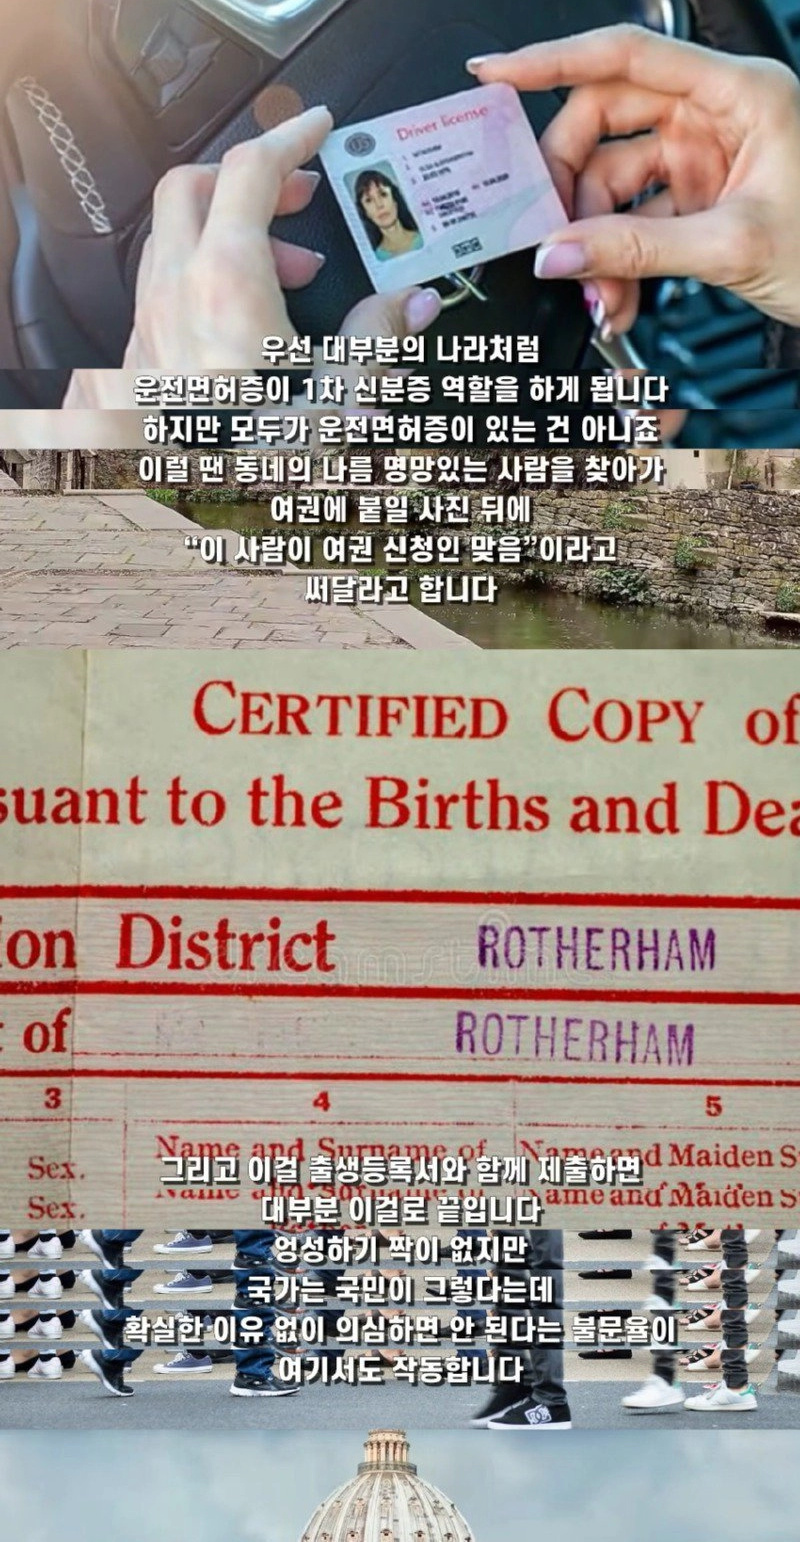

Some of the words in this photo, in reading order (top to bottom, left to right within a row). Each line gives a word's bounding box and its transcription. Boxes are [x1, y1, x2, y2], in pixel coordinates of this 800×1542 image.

[396, 122, 439, 141] Driver
[440, 105, 489, 129] license
[193, 680, 509, 740] CERTIFIED
[548, 687, 704, 744] COPY
[167, 776, 226, 827] to
[247, 774, 343, 829] the
[365, 776, 550, 831] Births
[569, 782, 681, 833] and
[116, 913, 336, 972] District
[477, 924, 717, 972] ROTHERHAM
[23, 1007, 72, 1054] of
[455, 1010, 695, 1067] ROTHERHAM
[44, 1087, 62, 1110] 3
[312, 1091, 331, 1112] 4
[704, 1095, 723, 1117] 5
[154, 1135, 240, 1162] Name
[669, 1142, 773, 1169] Maiden
[27, 1155, 86, 1180] Sex.
[26, 1195, 86, 1220] Sex.
